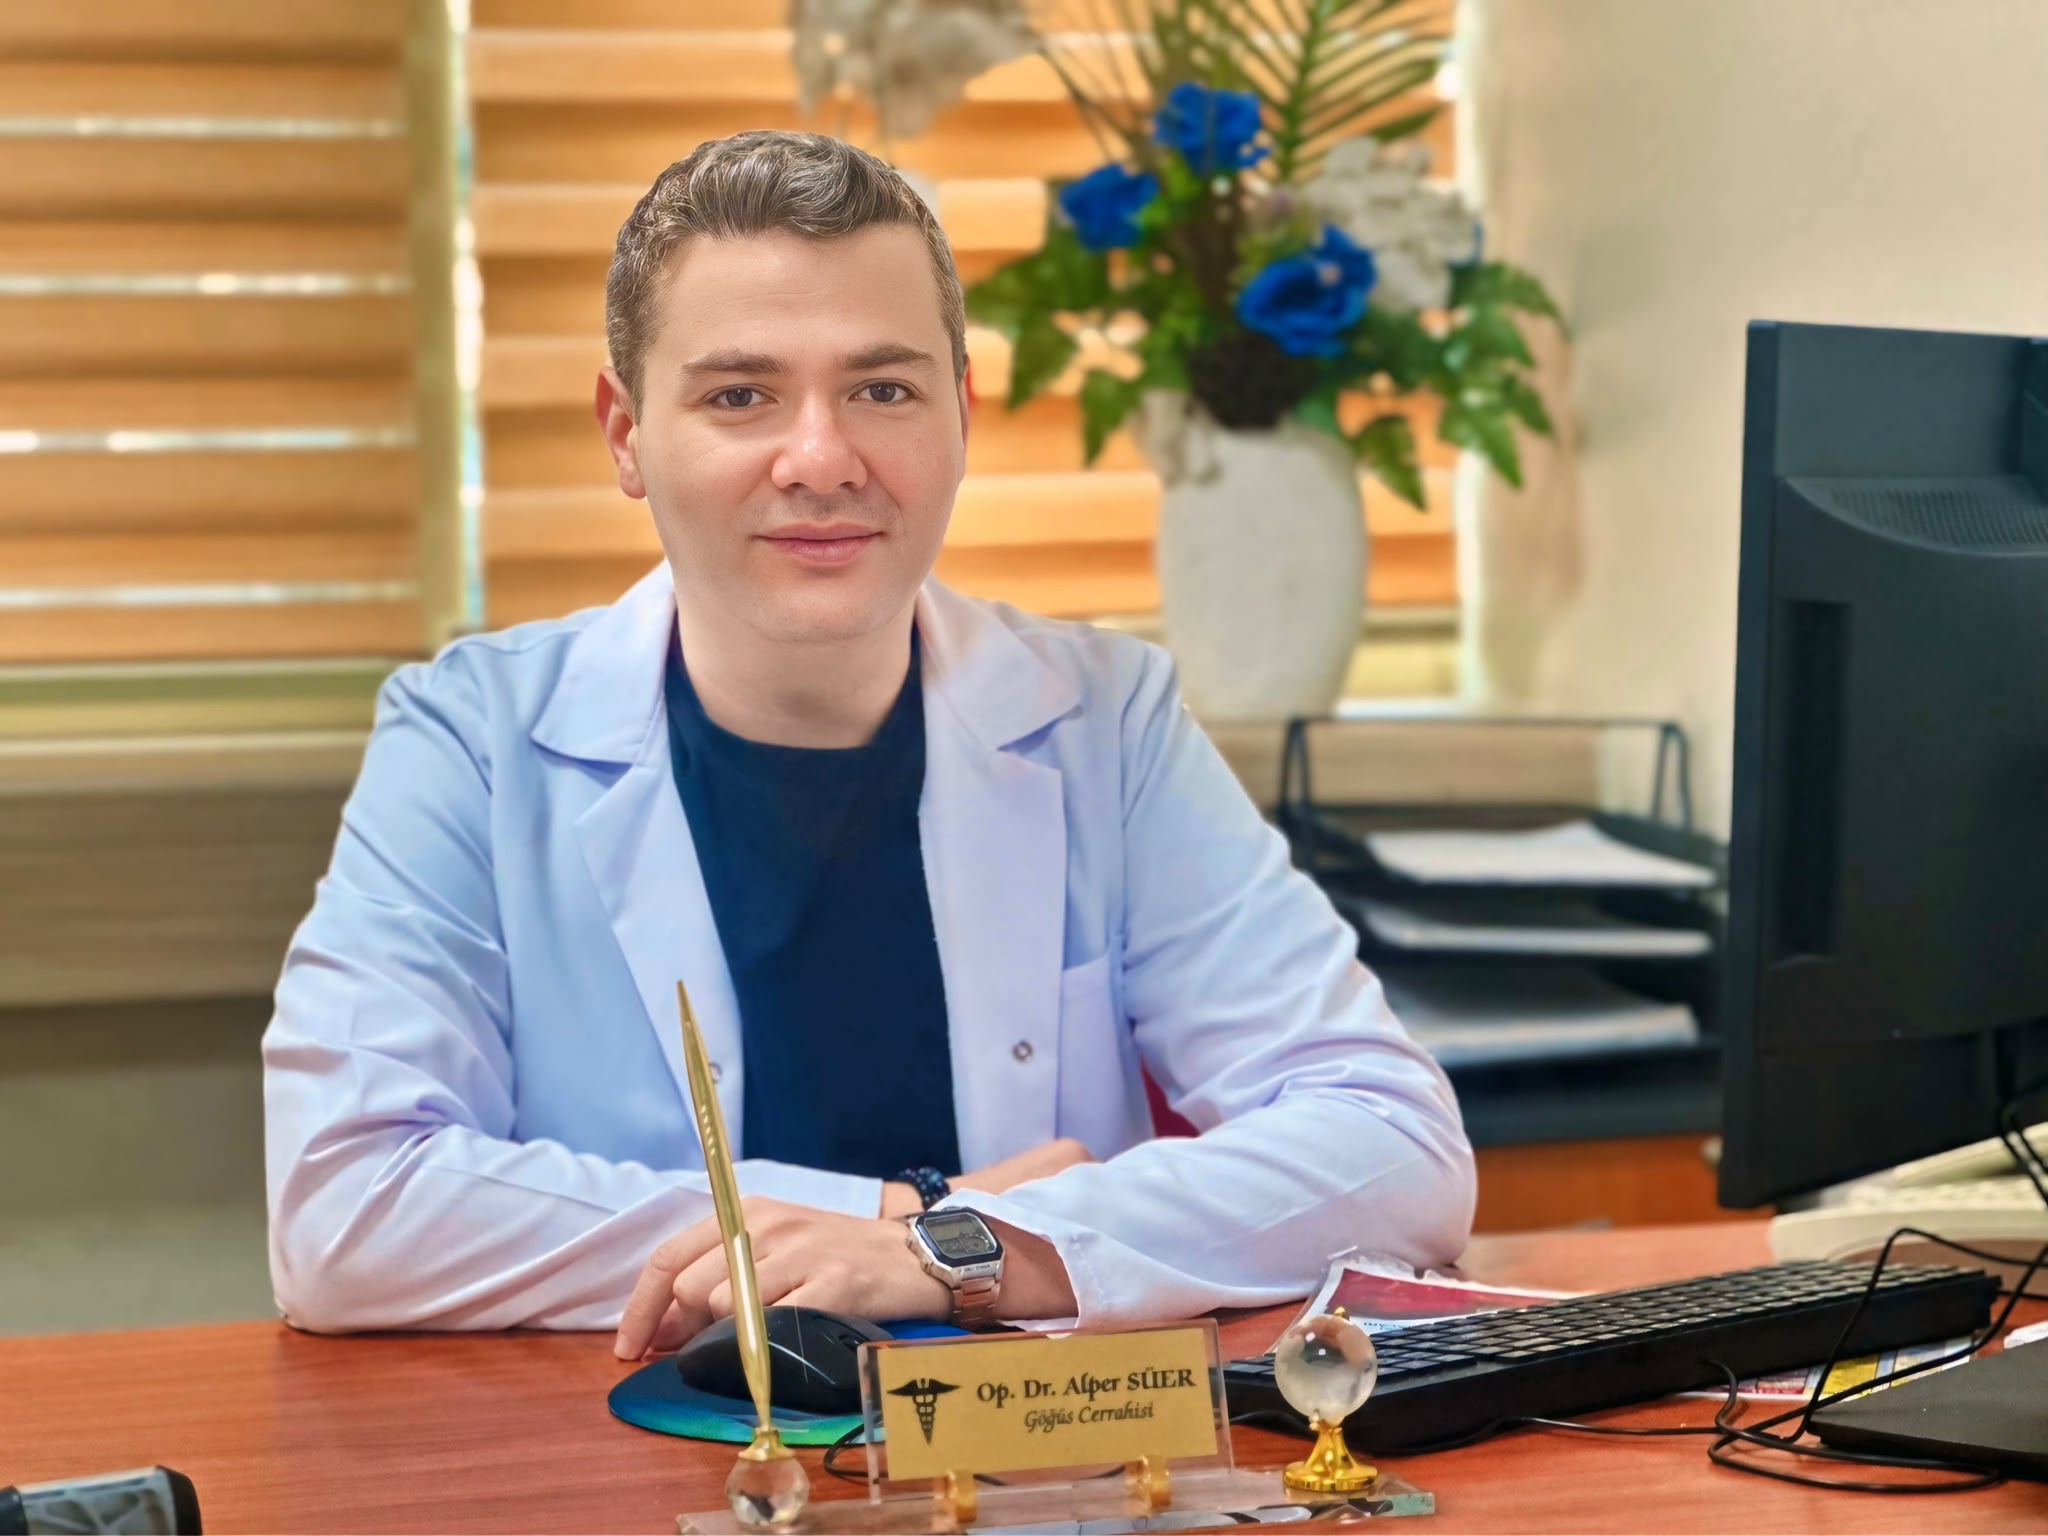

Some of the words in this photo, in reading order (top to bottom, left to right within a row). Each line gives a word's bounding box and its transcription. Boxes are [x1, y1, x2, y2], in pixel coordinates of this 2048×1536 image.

[976, 1381, 1015, 1408] Op.
[1023, 1379, 1056, 1399] Dr.
[1063, 1372, 1120, 1402] Alper
[1127, 1366, 1197, 1391] SÜER
[1024, 1408, 1074, 1433] Göğüs
[1078, 1401, 1154, 1424] Cerrahisi
